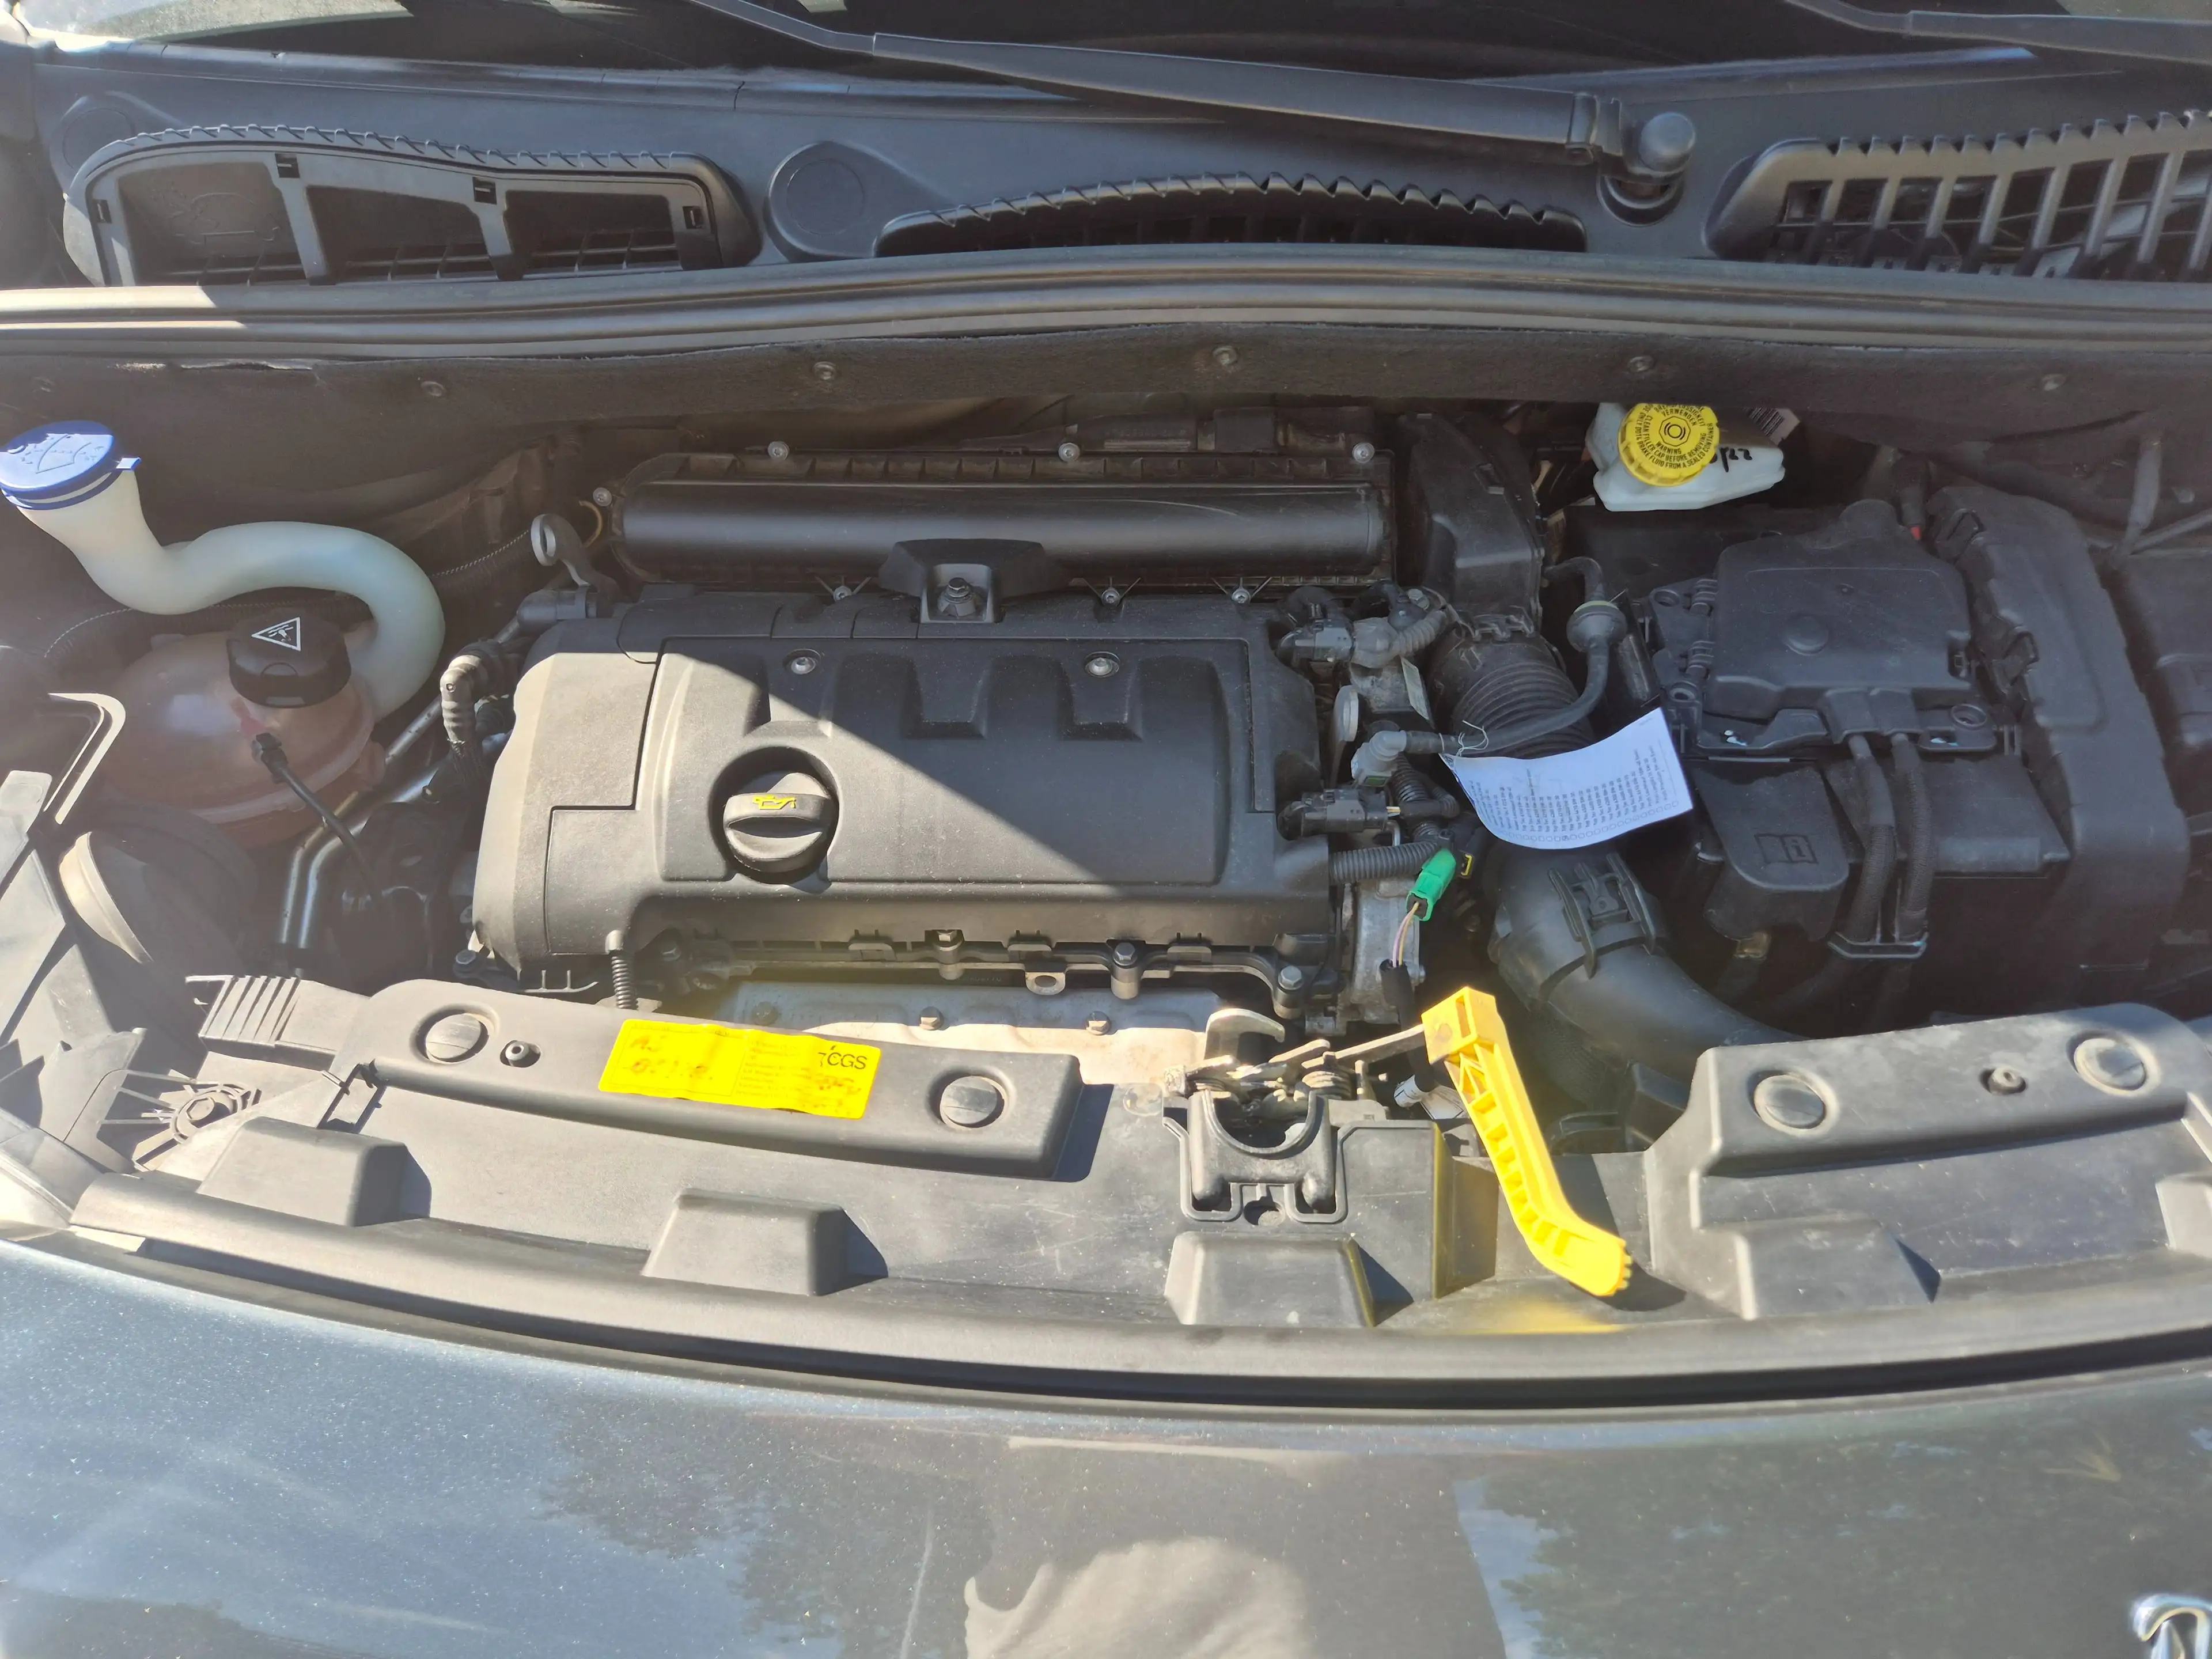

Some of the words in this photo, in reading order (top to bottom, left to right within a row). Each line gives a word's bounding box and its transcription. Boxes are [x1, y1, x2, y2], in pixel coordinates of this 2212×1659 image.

[1636, 412, 1646, 425] ONLY
[1642, 415, 1653, 432] CLEAN
[1661, 408, 1696, 426] VERWENDEN
[1642, 433, 1656, 452] FILLER
[1687, 433, 1706, 457] REMOVING
[1702, 423, 1714, 453] CONTAINER
[1637, 440, 1651, 457] BRAKE
[1654, 450, 1665, 459] CAP
[1656, 441, 1681, 454] WARNING
[1648, 455, 1665, 467] FLUID
[1665, 454, 1688, 462] BEFORE
[1687, 451, 1706, 467] SEALED
